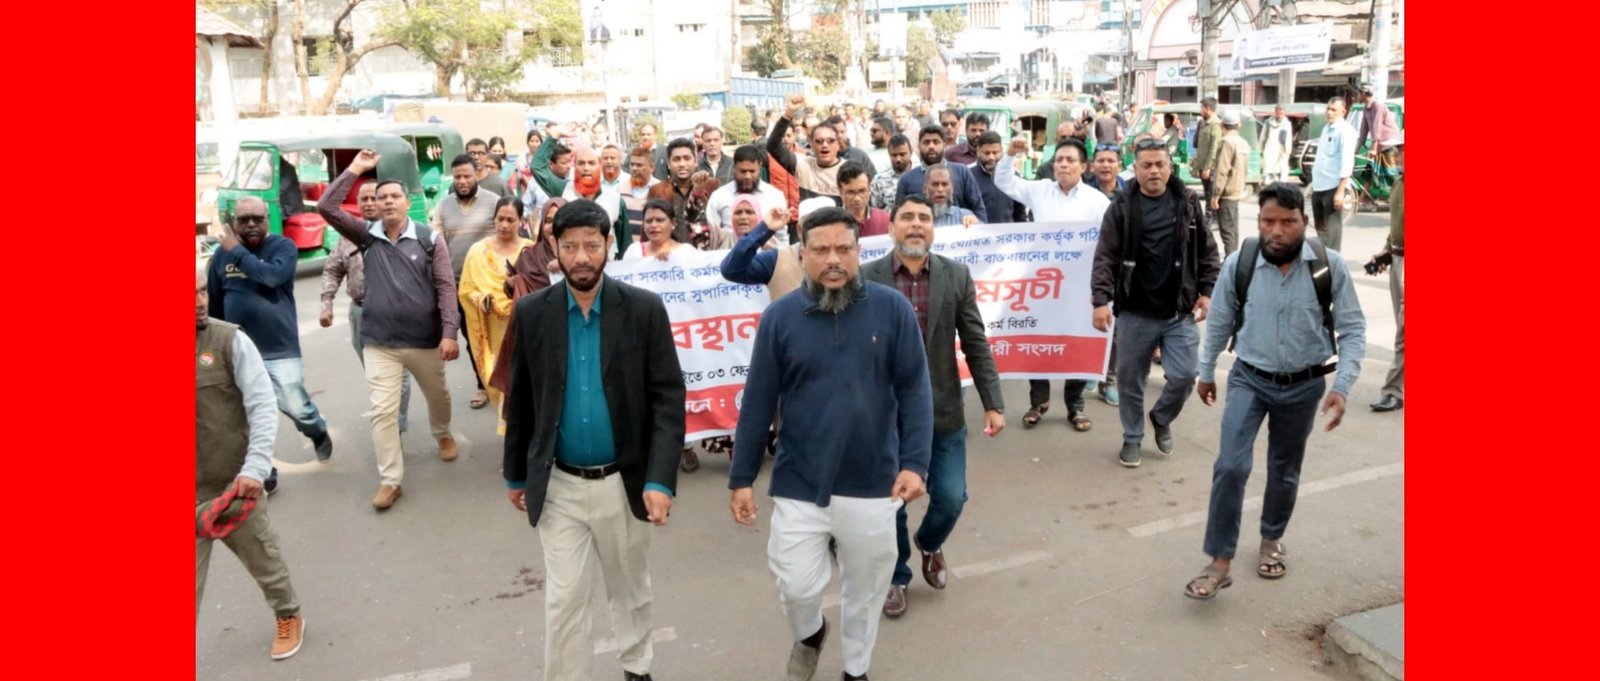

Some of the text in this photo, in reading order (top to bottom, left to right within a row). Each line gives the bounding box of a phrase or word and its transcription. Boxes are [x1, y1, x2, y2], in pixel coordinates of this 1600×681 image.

[638, 266, 685, 283] সরকারি
[691, 263, 720, 278] কর্মচ
[996, 233, 1036, 243] সরকার
[1041, 228, 1075, 246] কর্তৃক
[1079, 227, 1101, 241] গঠি
[670, 267, 1064, 351] বস্থান র্মসূচী
[708, 368, 725, 379] ০৩
[987, 318, 1005, 329] কর্ম
[1008, 317, 1039, 329] বিরতি
[1016, 342, 1067, 356] সংসদ
